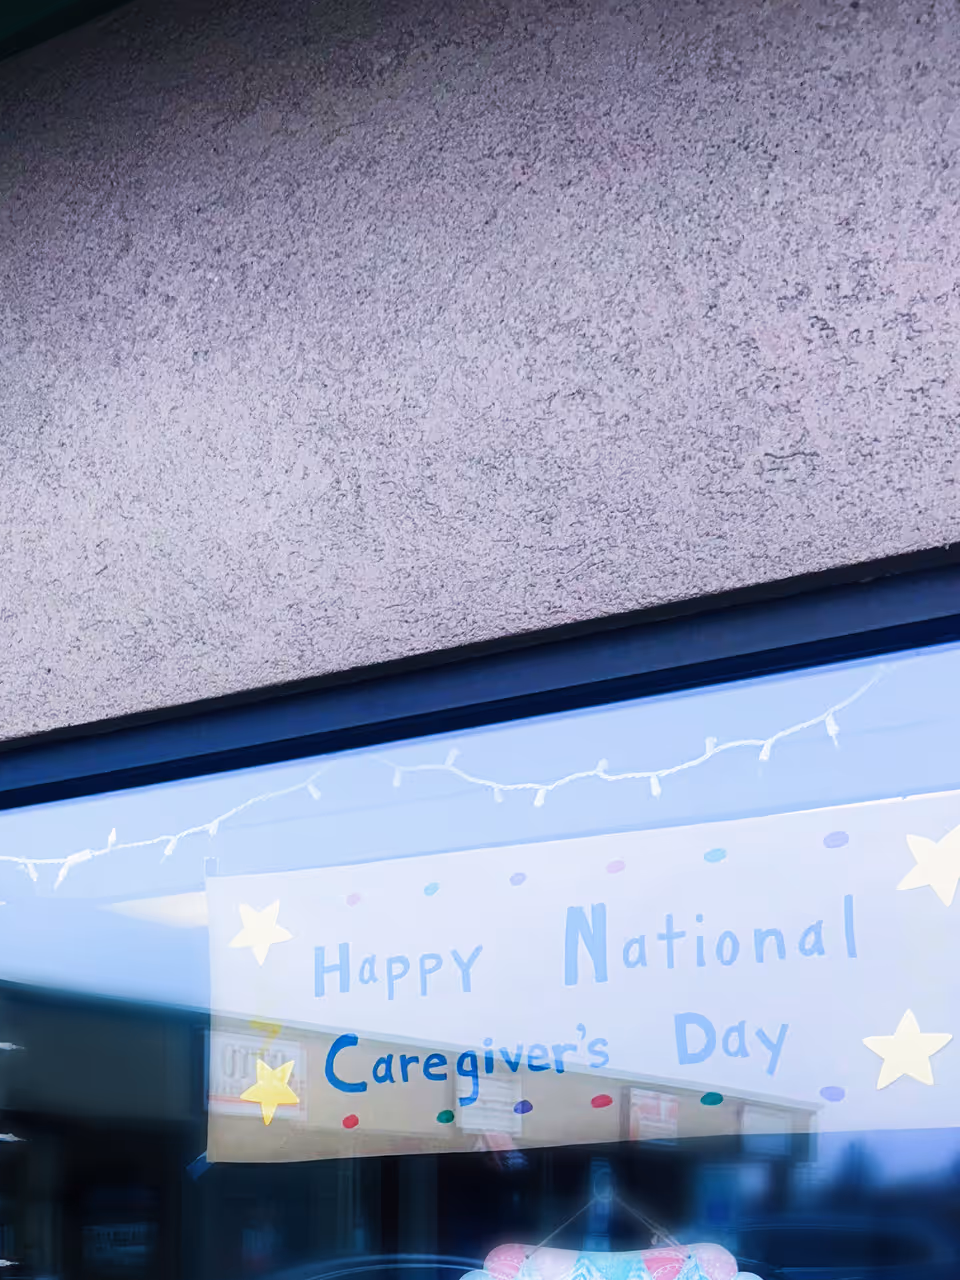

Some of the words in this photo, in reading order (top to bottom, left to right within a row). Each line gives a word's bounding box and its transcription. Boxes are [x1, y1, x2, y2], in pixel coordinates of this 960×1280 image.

[563, 895, 858, 986] National
[324, 1022, 610, 1107] Caregiver's
[673, 1011, 789, 1076] Day
